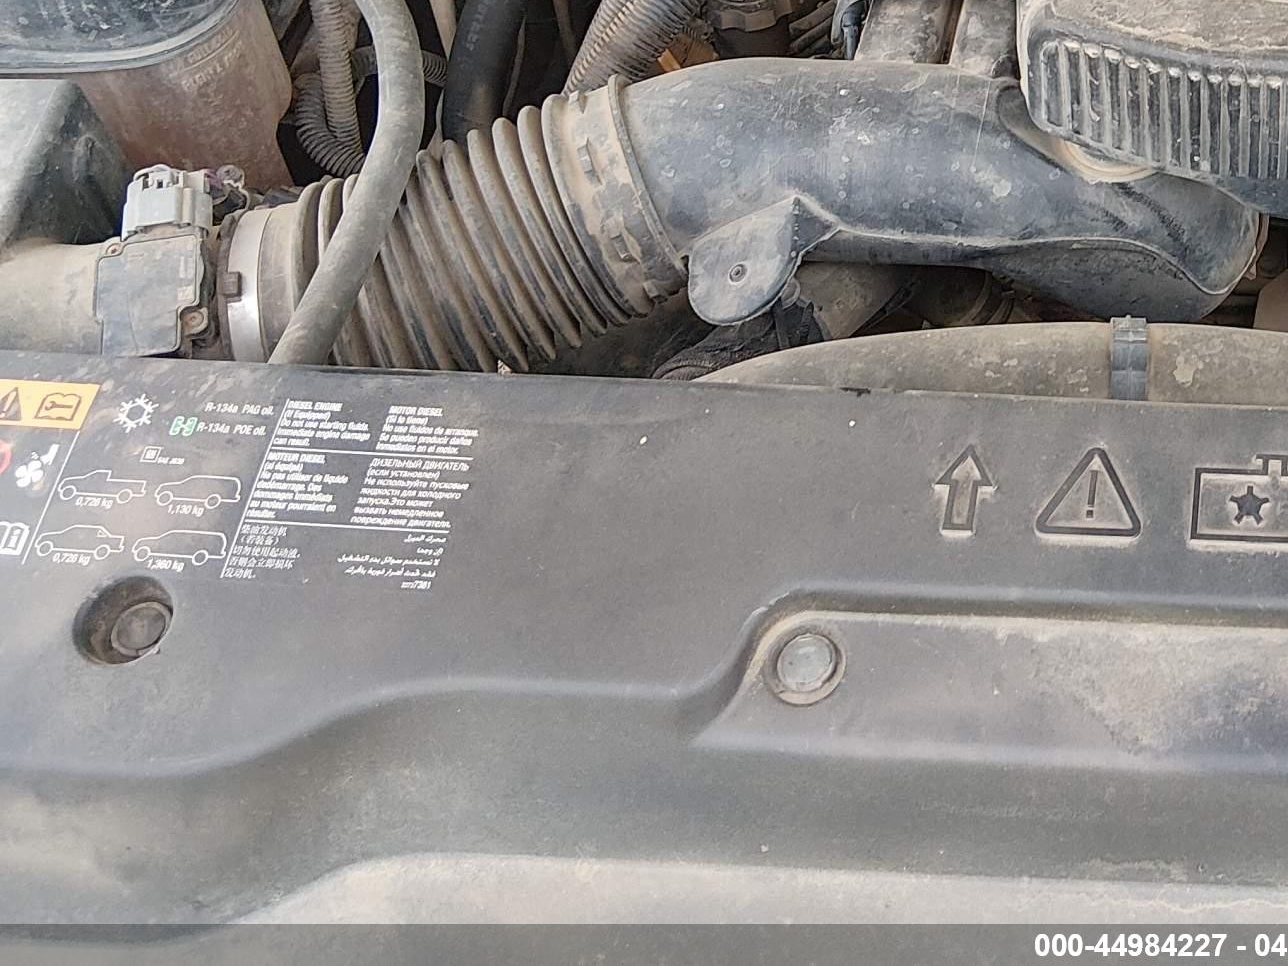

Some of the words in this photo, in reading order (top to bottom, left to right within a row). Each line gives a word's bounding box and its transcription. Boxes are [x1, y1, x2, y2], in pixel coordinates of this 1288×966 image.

[205, 402, 238, 414] R-134a
[242, 404, 261, 414] PAG
[261, 406, 274, 416] oil.
[287, 400, 313, 410] DIESEL
[314, 402, 343, 412] ENGINE
[388, 406, 417, 415] MOTOR
[417, 407, 443, 416] DIESEL
[196, 422, 230, 434] R-134a
[233, 424, 252, 434] POE
[252, 426, 266, 436] oil.
[319, 421, 347, 432] starting
[382, 424, 394, 432] No
[315, 430, 340, 439] engine
[340, 431, 370, 442] damage
[390, 434, 418, 442] pueden
[417, 436, 450, 444] producir
[266, 452, 300, 462] MOTEUR
[300, 454, 326, 464] DIESEL
[370, 458, 422, 468] ДИЗЕЛЬНЫЙ
[422, 460, 470, 472] ДВИГАТЕЛЬ
[271, 472, 286, 482] pas
[312, 474, 323, 482] de
[389, 469, 440, 480] установлен)
[364, 476, 376, 486] Не
[376, 478, 428, 489] используйте
[429, 482, 470, 490] пусковые
[400, 490, 416, 498] для
[417, 491, 462, 499] холодного
[100, 498, 114, 508] kg
[260, 500, 288, 509] moteur
[326, 504, 336, 512] en
[167, 504, 191, 514] 1,130
[192, 506, 204, 517] kg
[354, 506, 387, 514] вызвать
[388, 508, 444, 518] немедленное
[350, 516, 408, 526] повреждение
[78, 554, 91, 566] kg
[171, 560, 184, 572] kg
